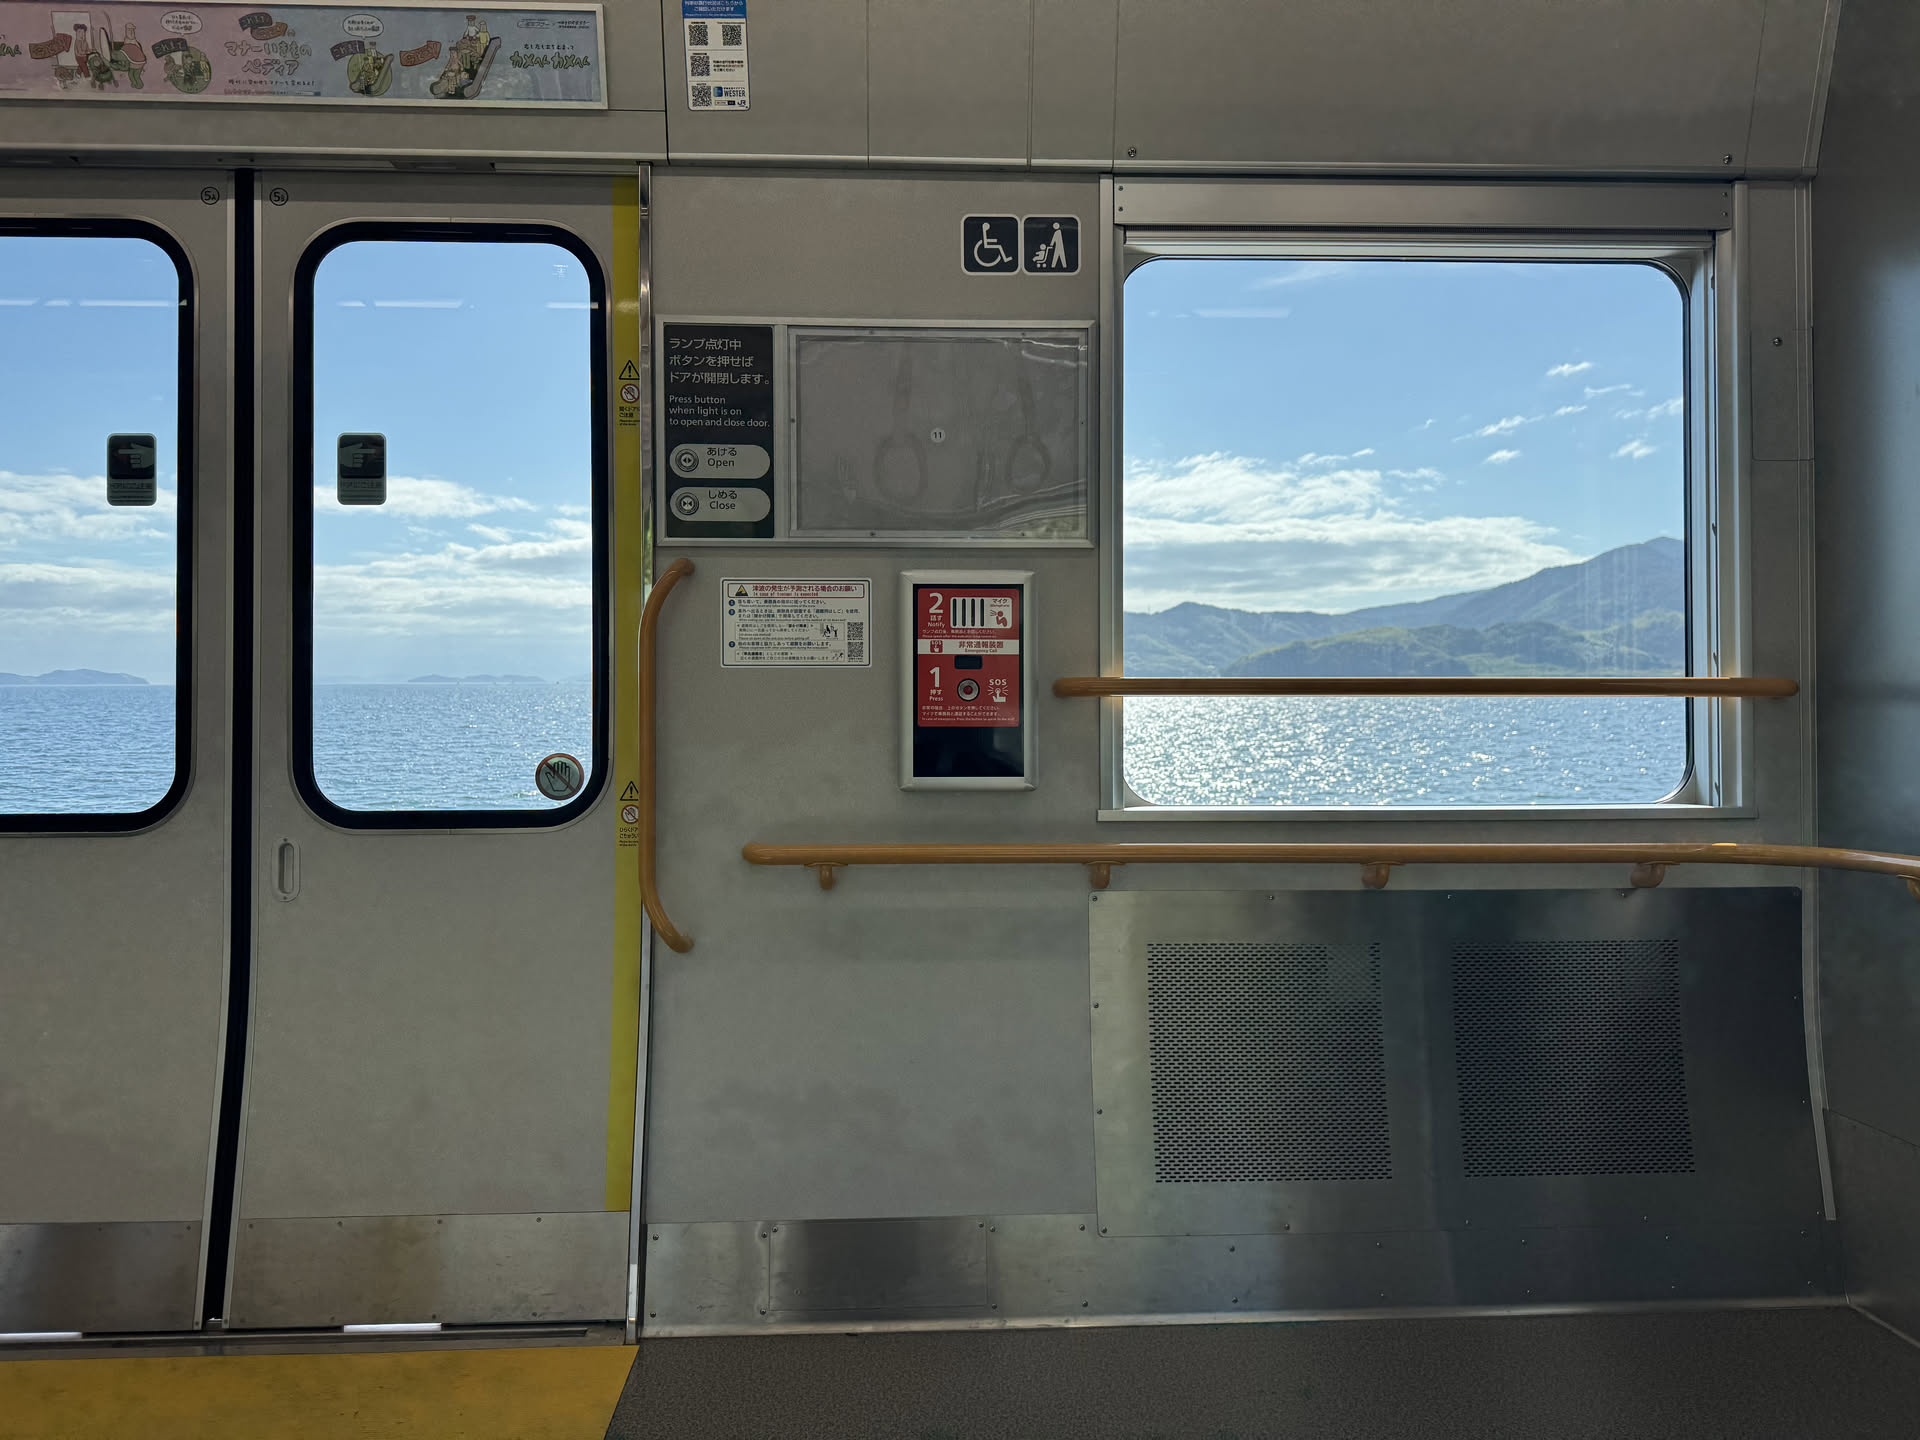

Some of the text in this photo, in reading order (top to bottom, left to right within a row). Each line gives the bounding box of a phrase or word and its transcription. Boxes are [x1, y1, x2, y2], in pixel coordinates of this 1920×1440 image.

[669, 338, 742, 351] ランプ点灯中
[669, 355, 754, 367] ボタンを押せば
[670, 372, 769, 385] ドアが開閉します。
[669, 395, 726, 404] Press button
[669, 406, 695, 414] when
[697, 406, 718, 416] light
[720, 407, 728, 415] is
[680, 419, 703, 428] open
[705, 417, 722, 426] and
[724, 417, 745, 426] close
[746, 418, 770, 427] door.
[707, 447, 737, 456] あける
[707, 458, 735, 468] Open
[708, 490, 737, 500] しめる
[709, 501, 736, 510] Close
[929, 592, 944, 613] 2
[927, 621, 945, 629] Notify
[929, 667, 940, 688] 1
